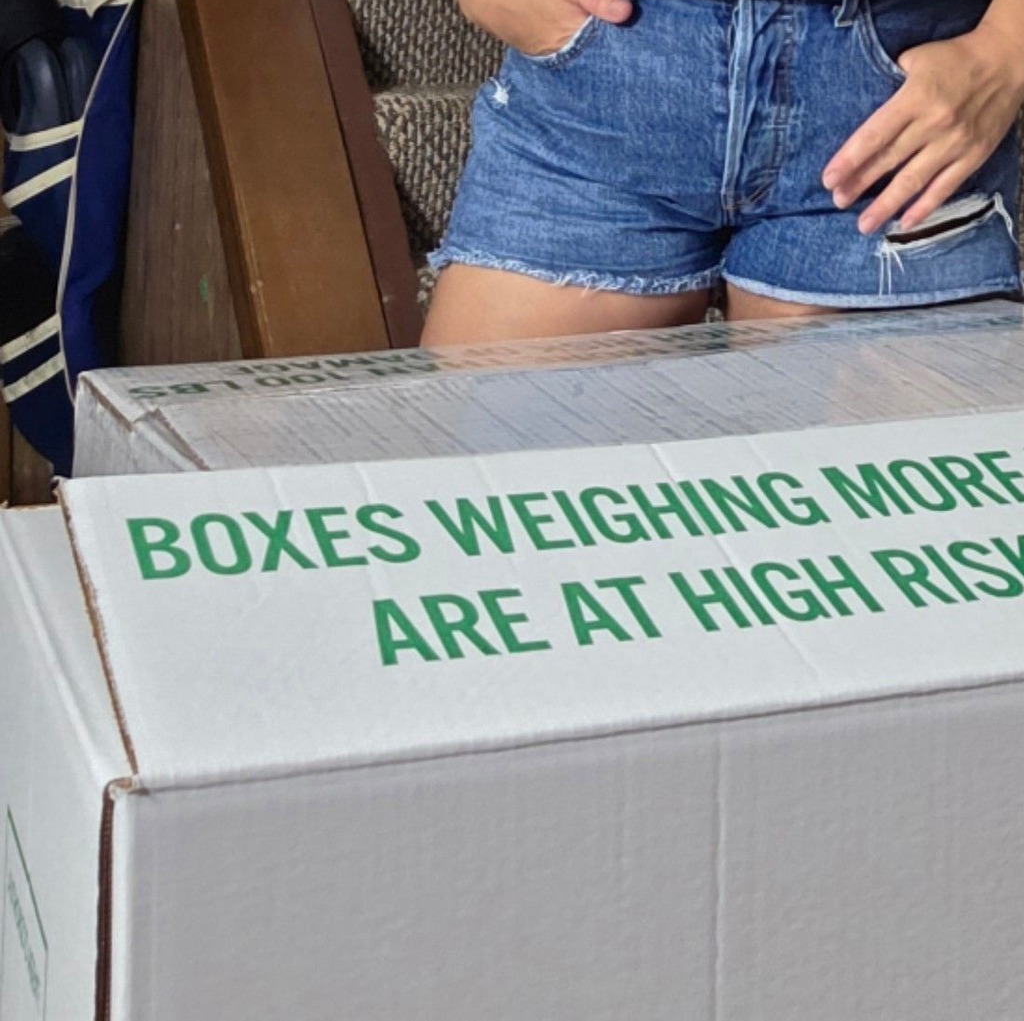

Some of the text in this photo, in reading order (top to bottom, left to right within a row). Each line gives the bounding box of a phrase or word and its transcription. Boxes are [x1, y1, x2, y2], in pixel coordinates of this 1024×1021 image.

[127, 502, 422, 581] BOXES
[424, 472, 829, 557] WEIGHING
[372, 588, 552, 666] ARE
[560, 575, 662, 647] AT
[668, 553, 884, 633] HIGH
